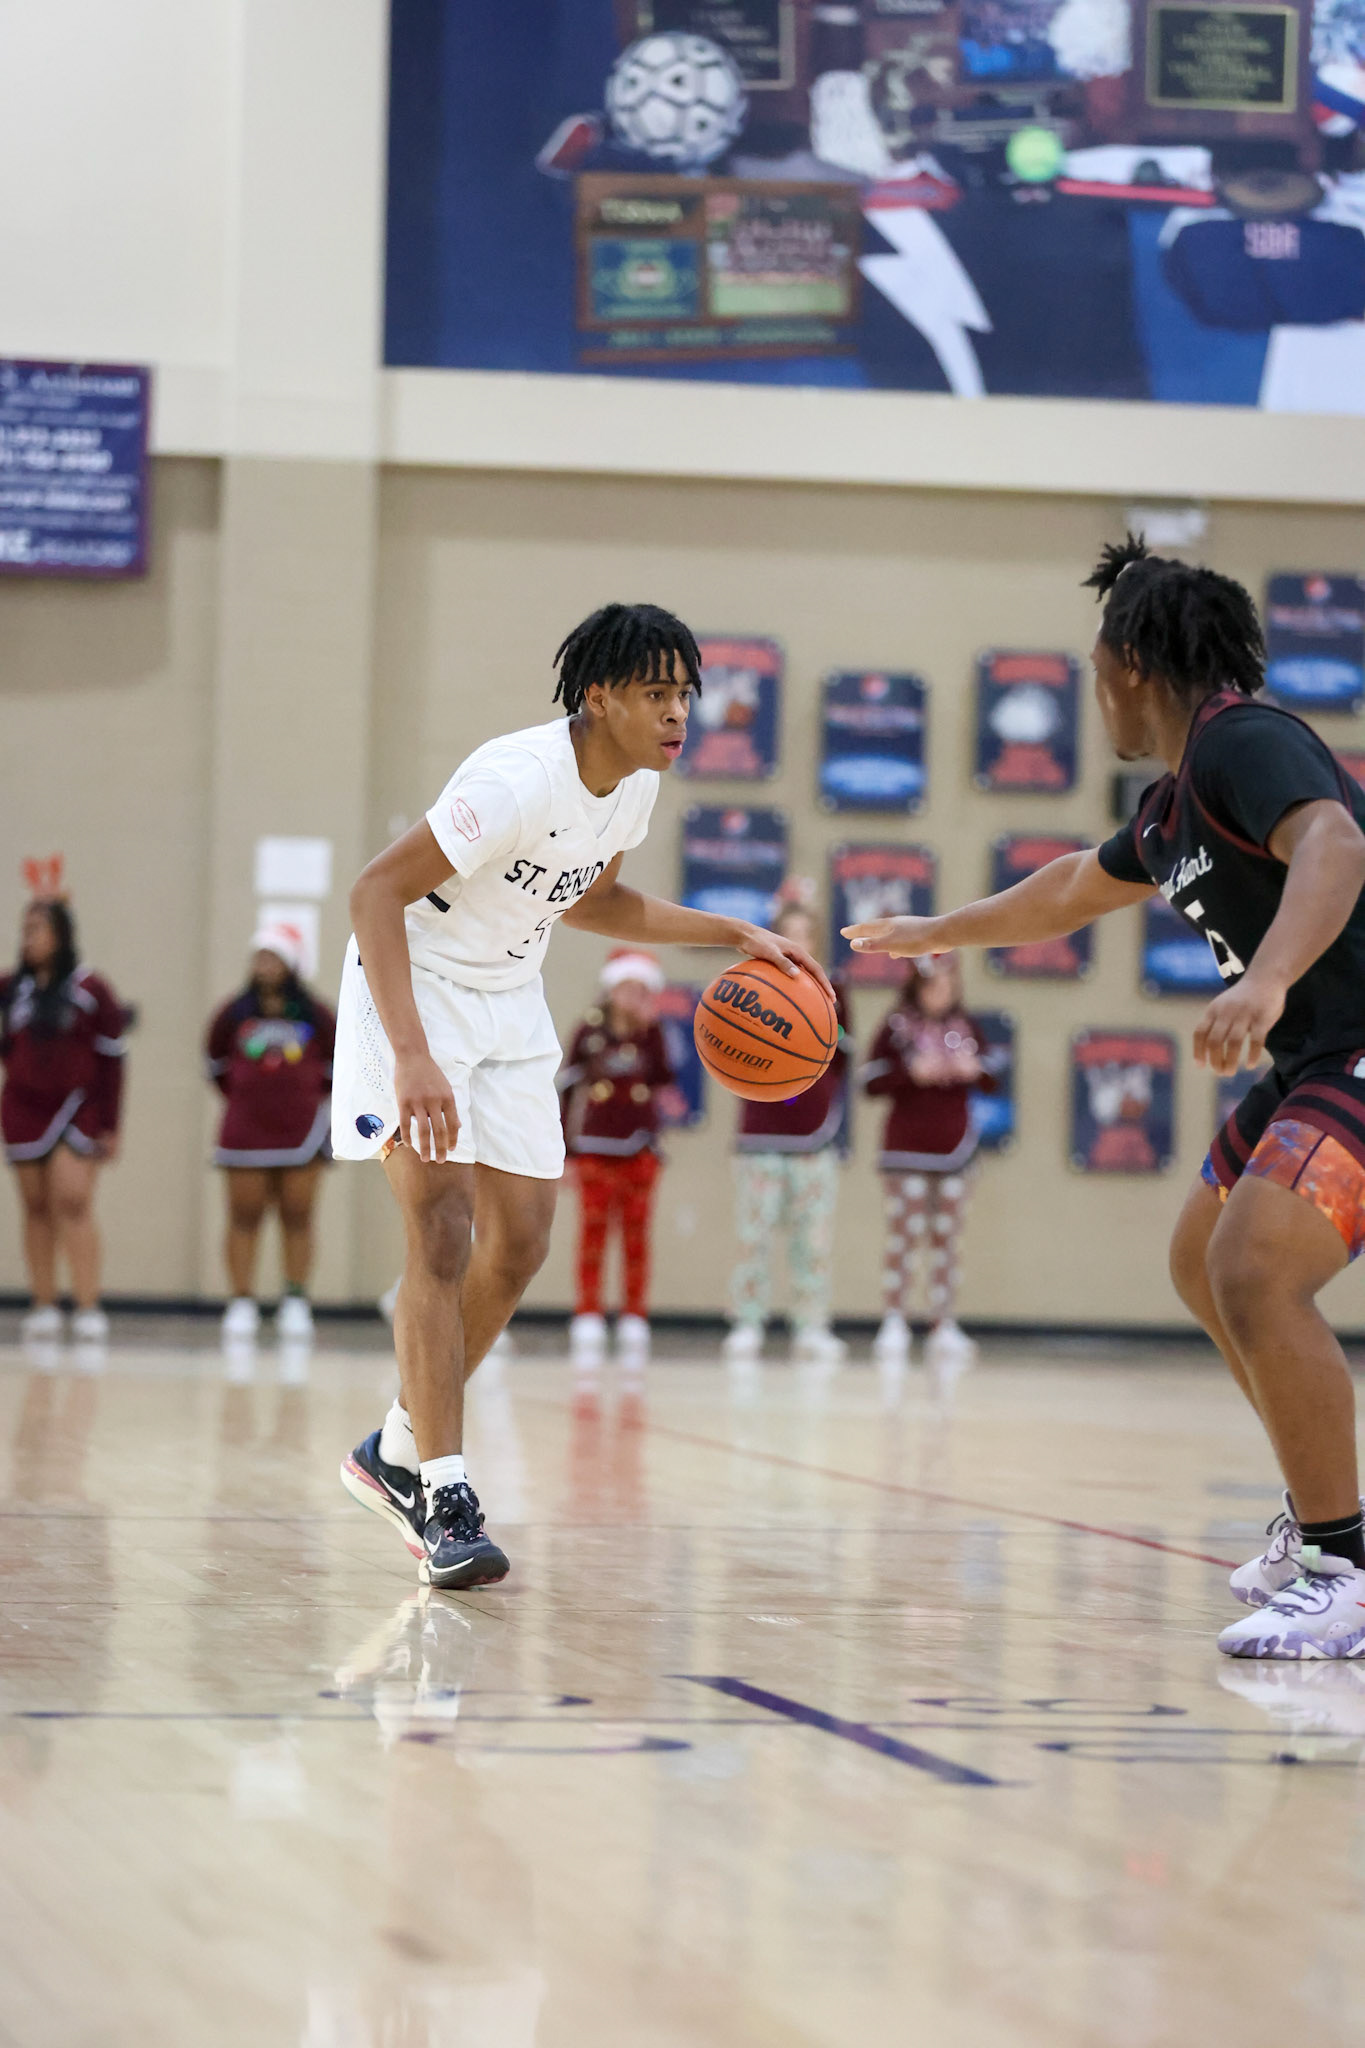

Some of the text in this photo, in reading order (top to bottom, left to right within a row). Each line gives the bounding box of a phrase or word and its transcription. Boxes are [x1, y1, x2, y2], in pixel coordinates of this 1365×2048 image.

[503, 858, 548, 896] ST.
[712, 979, 793, 1040] Wilson
[699, 1023, 774, 1071] EVOLUTION
